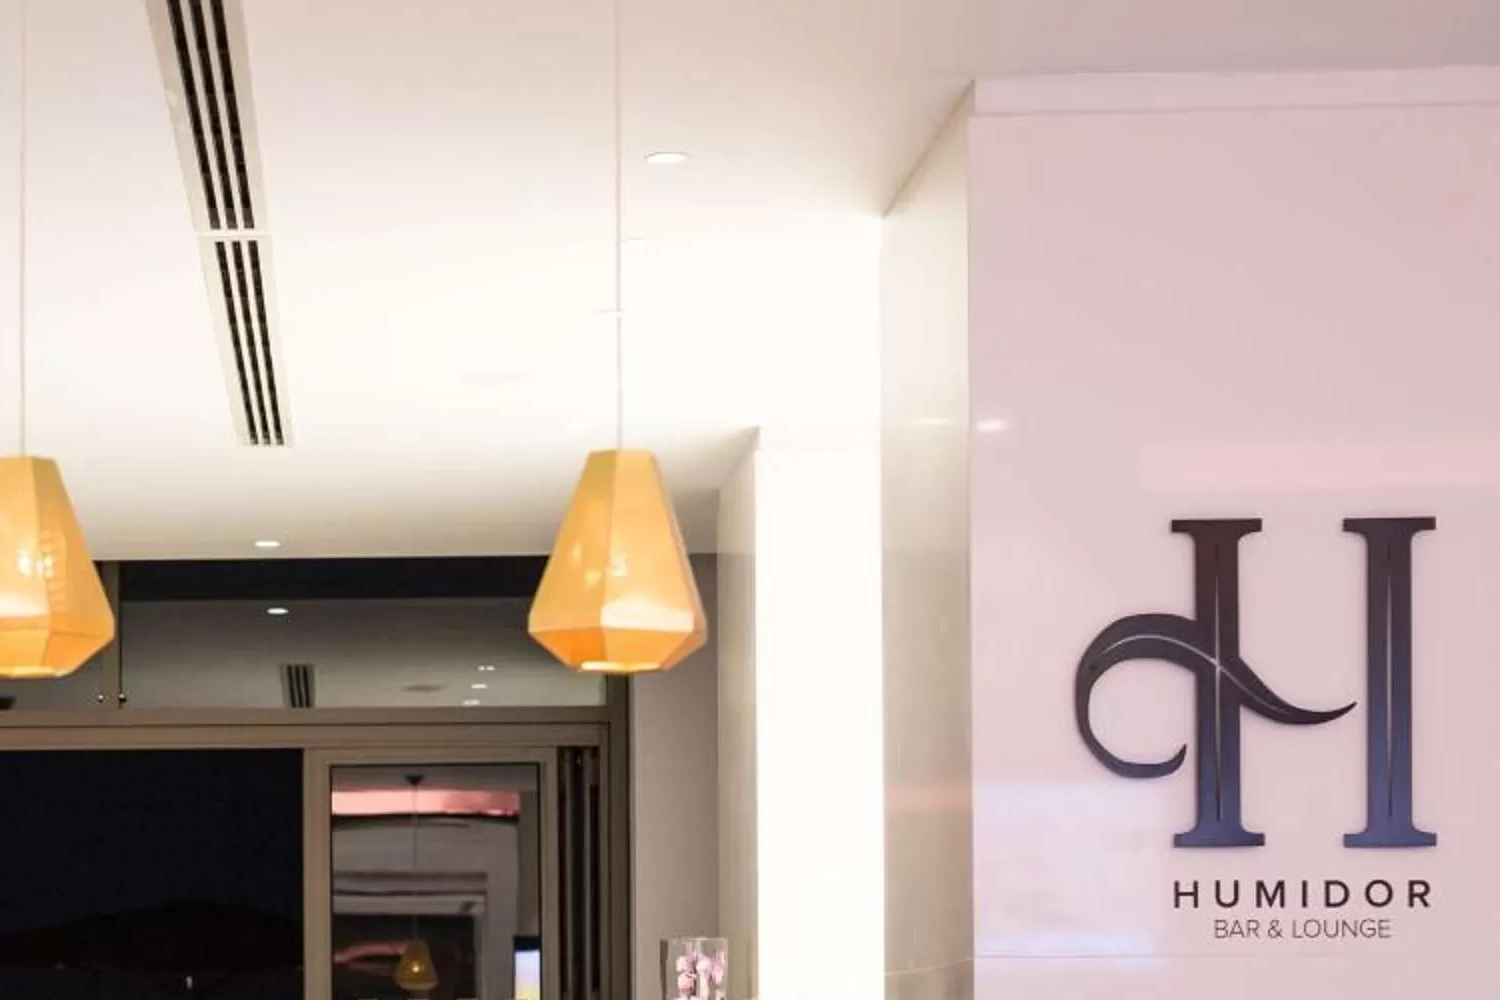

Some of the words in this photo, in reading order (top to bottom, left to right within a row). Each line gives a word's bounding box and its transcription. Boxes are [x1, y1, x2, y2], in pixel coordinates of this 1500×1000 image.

[1173, 879, 1431, 909] HUMIDOR
[1214, 919, 1260, 939] BAR
[1267, 919, 1283, 939] &
[1292, 919, 1392, 939] LOUNGE
